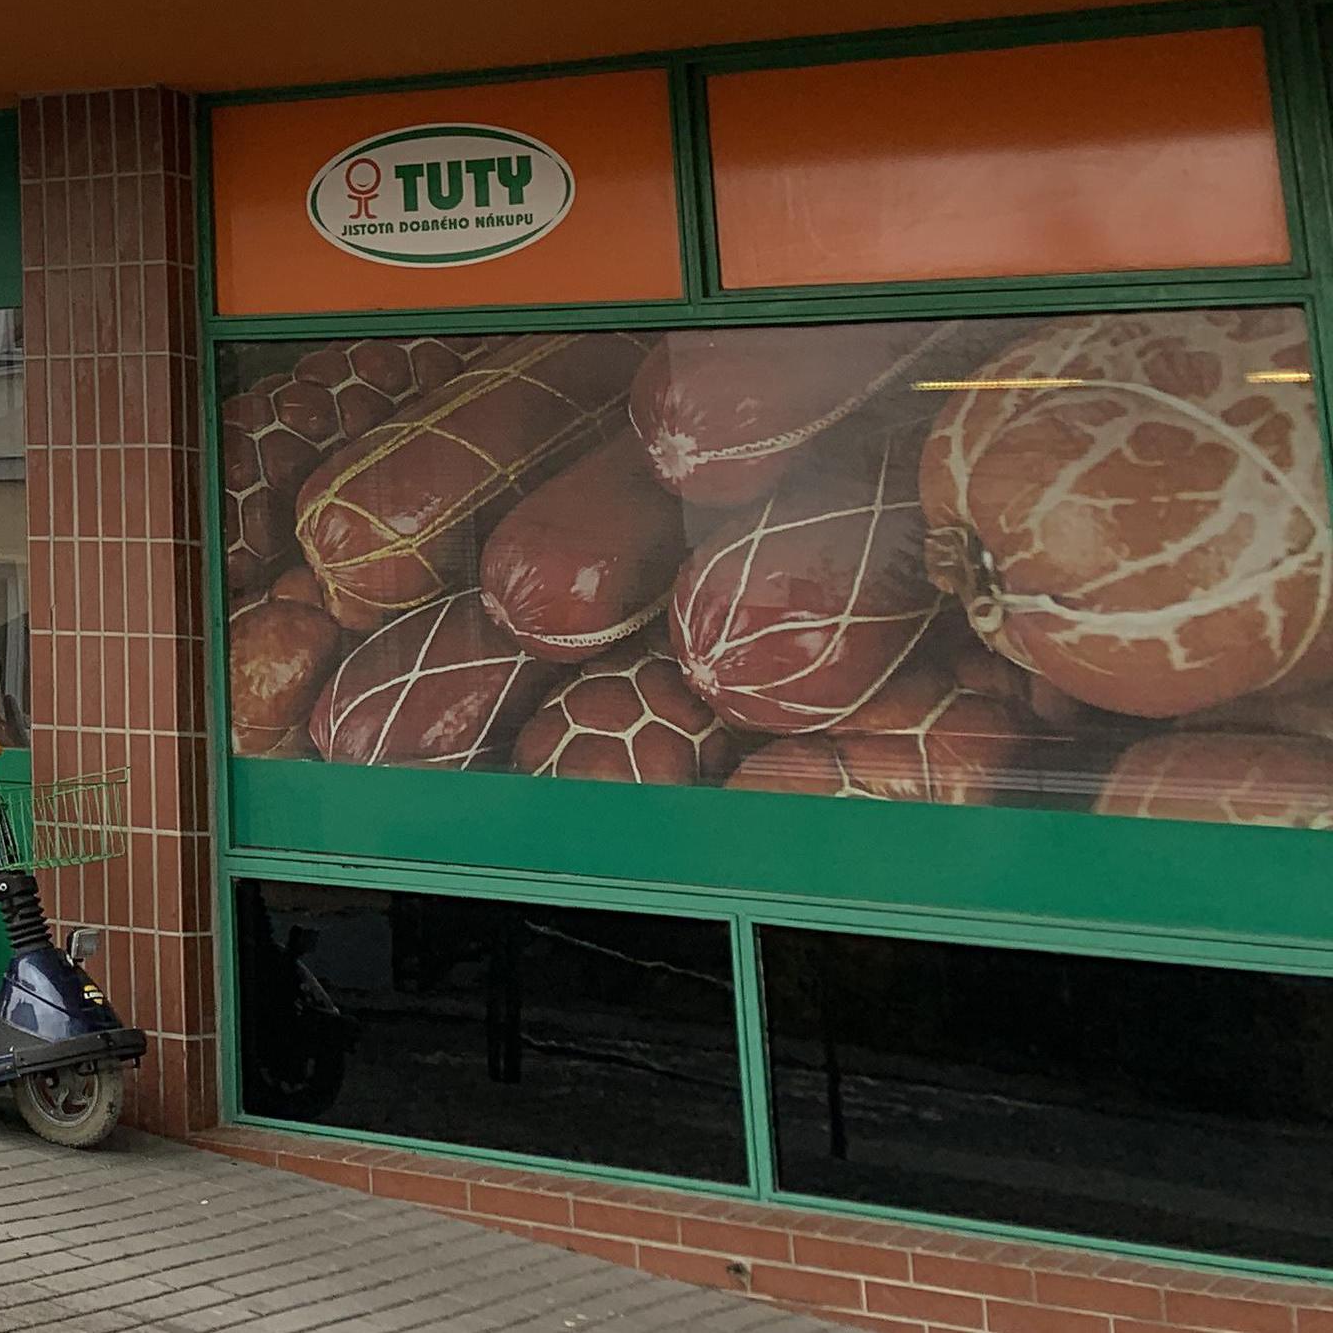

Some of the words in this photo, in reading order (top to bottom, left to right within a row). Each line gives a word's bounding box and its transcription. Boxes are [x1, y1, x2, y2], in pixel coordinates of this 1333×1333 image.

[395, 155, 533, 213] TUTY
[341, 222, 394, 236] JISTOTA
[399, 216, 470, 234] DOBRÉHO
[475, 213, 534, 228] NÁKUPU
